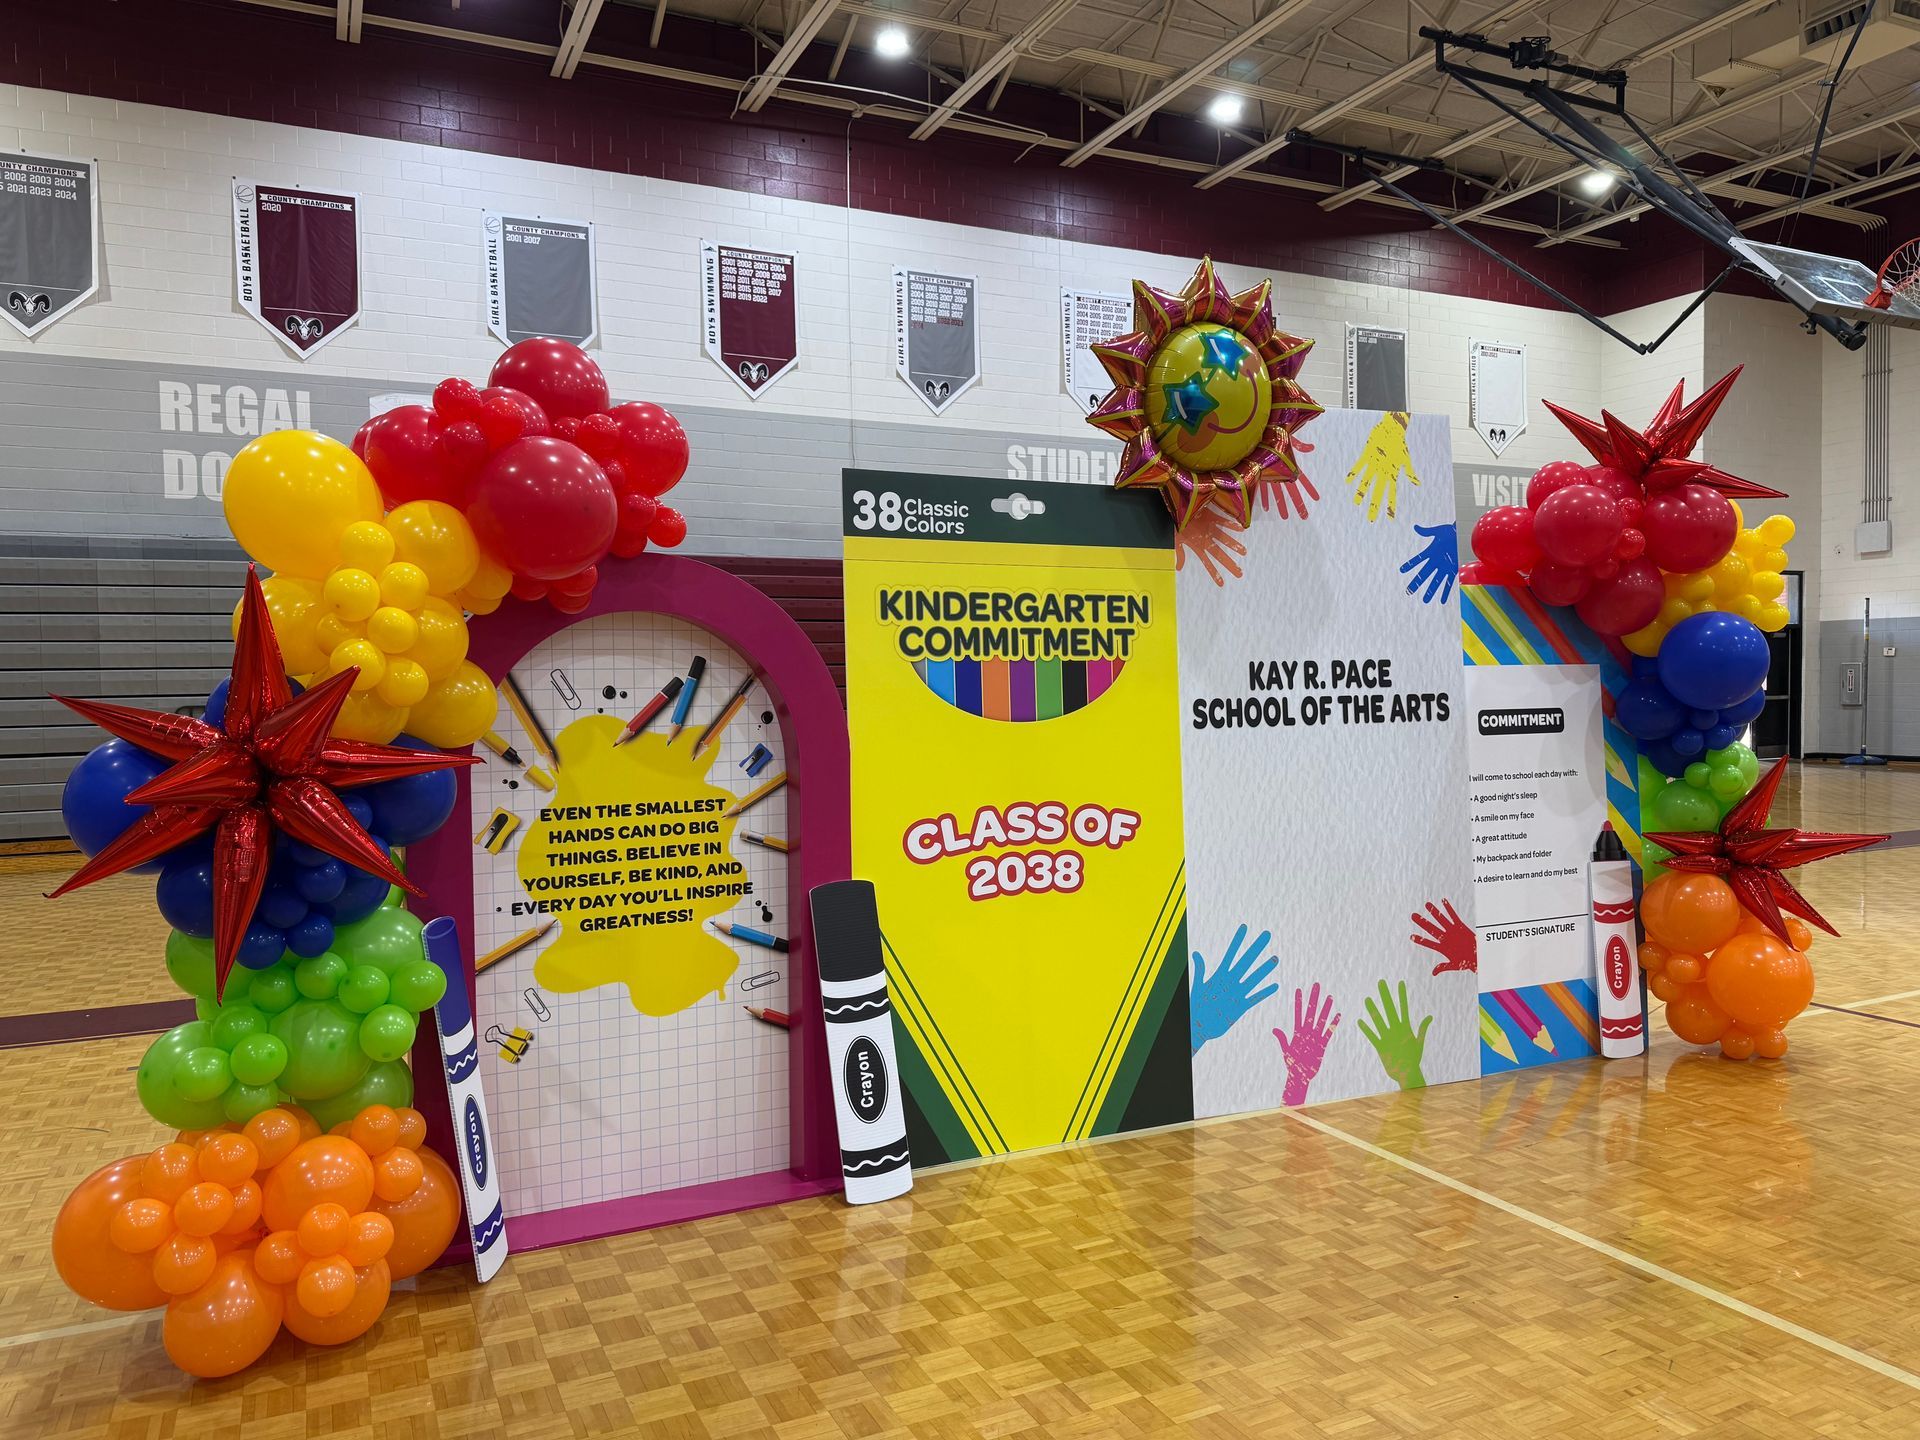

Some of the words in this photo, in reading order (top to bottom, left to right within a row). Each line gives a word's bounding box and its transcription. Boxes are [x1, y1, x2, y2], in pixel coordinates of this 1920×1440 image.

[4, 171, 26, 182] 2002
[29, 174, 52, 185] 2003
[54, 177, 76, 188] 2004
[26, 164, 78, 177] CHAMPIONS
[7, 183, 27, 194] 2021
[29, 186, 52, 197] 2023
[55, 189, 77, 200] 2024
[267, 195, 297, 204] COUNTY
[300, 199, 345, 210] CHAMPIONS
[261, 202, 282, 212] 2020
[240, 207, 251, 272] BASKETBALL
[505, 234, 522, 243] 2001
[523, 235, 541, 245] 2007
[512, 225, 539, 234] COUNTY
[540, 228, 580, 239] CHAMPIONS
[488, 238, 498, 296] BASKETBALL
[721, 257, 735, 266] 2001
[737, 260, 752, 268] 2002
[753, 262, 769, 270] 2003
[770, 264, 785, 273] 2004
[751, 254, 786, 264] CHAMPIONS
[722, 266, 737, 274] 2005
[738, 268, 754, 276] 2007
[722, 274, 736, 282] 2010
[737, 276, 750, 284] 2011
[751, 278, 765, 286] 2012
[766, 280, 780, 288] 2013
[242, 276, 252, 302] BOYS
[706, 258, 715, 313] SWIMMING
[722, 283, 736, 291] 2014
[738, 285, 752, 293] 2015
[768, 288, 782, 296] 2017
[936, 279, 966, 287] CHAMPIONS
[752, 295, 768, 303] 2022
[896, 281, 904, 333] SWIMMING
[491, 299, 500, 326] GIRLS
[708, 317, 716, 344] BOYS
[158, 380, 318, 436] REGAL
[852, 489, 903, 531] 38
[903, 498, 969, 518] Classic
[903, 516, 965, 535] Colors
[879, 589, 1149, 624] KINDERGARTEN
[898, 625, 1136, 657] COMMITMENT
[1249, 660, 1299, 691] KAY
[1303, 660, 1326, 690] R.
[1331, 659, 1393, 689] PACE
[1192, 696, 1296, 730] SCHOOL
[1301, 695, 1333, 726] OF
[1337, 694, 1386, 725] THE
[1390, 692, 1450, 723] ARTS
[1480, 713, 1562, 728] COMMITMENT
[1472, 774, 1484, 782] will
[1512, 771, 1534, 779] school
[1534, 770, 1550, 778] each
[1550, 770, 1562, 779] day
[1562, 769, 1578, 777] with:
[1480, 793, 1497, 804] good
[1497, 792, 1520, 802] night's
[1520, 791, 1538, 800] sleep
[540, 805, 592, 822] EVEN
[594, 803, 632, 819] THE
[635, 798, 727, 817] SMALLEST
[1480, 813, 1499, 822] smile
[1509, 814, 1520, 822] my
[1520, 811, 1535, 819] face
[548, 826, 615, 844] HANDS
[618, 824, 657, 840] CAN
[659, 821, 686, 837] DO
[689, 820, 719, 835] BIG
[905, 803, 1066, 862] CLASS
[1072, 806, 1139, 847] OF
[1475, 835, 1481, 843] A
[1481, 834, 1499, 844] great
[1500, 832, 1528, 841] attitude
[546, 848, 623, 867] THINGS.
[626, 843, 701, 861] BELIEVE
[704, 841, 722, 855] IN
[1476, 855, 1487, 864] My
[1487, 852, 1518, 862] backpack
[1519, 851, 1532, 860] and
[1532, 850, 1552, 858] folder
[523, 871, 625, 892] YOURSELF,
[628, 868, 653, 883] BE
[656, 864, 702, 881] KIND,
[705, 861, 743, 877] AND
[967, 852, 1082, 898] 2038
[1483, 874, 1504, 883] desire
[1505, 873, 1513, 881] to
[1513, 871, 1530, 880] learn
[1530, 870, 1543, 878] and
[1544, 869, 1552, 877] do
[1553, 870, 1564, 878] my
[1564, 867, 1578, 876] best
[511, 897, 576, 916] EVERY
[579, 893, 617, 910] DAY
[620, 888, 683, 907] YOU'LL
[686, 882, 754, 900] INSPIRE
[579, 908, 694, 933] GREATNESS!
[1486, 928, 1530, 942] STUDENT'S
[1532, 923, 1576, 936] SIGNATURE
[1613, 946, 1623, 989] Crayon
[857, 1050, 875, 1108] Crayon
[468, 1110, 483, 1174] Crayon
